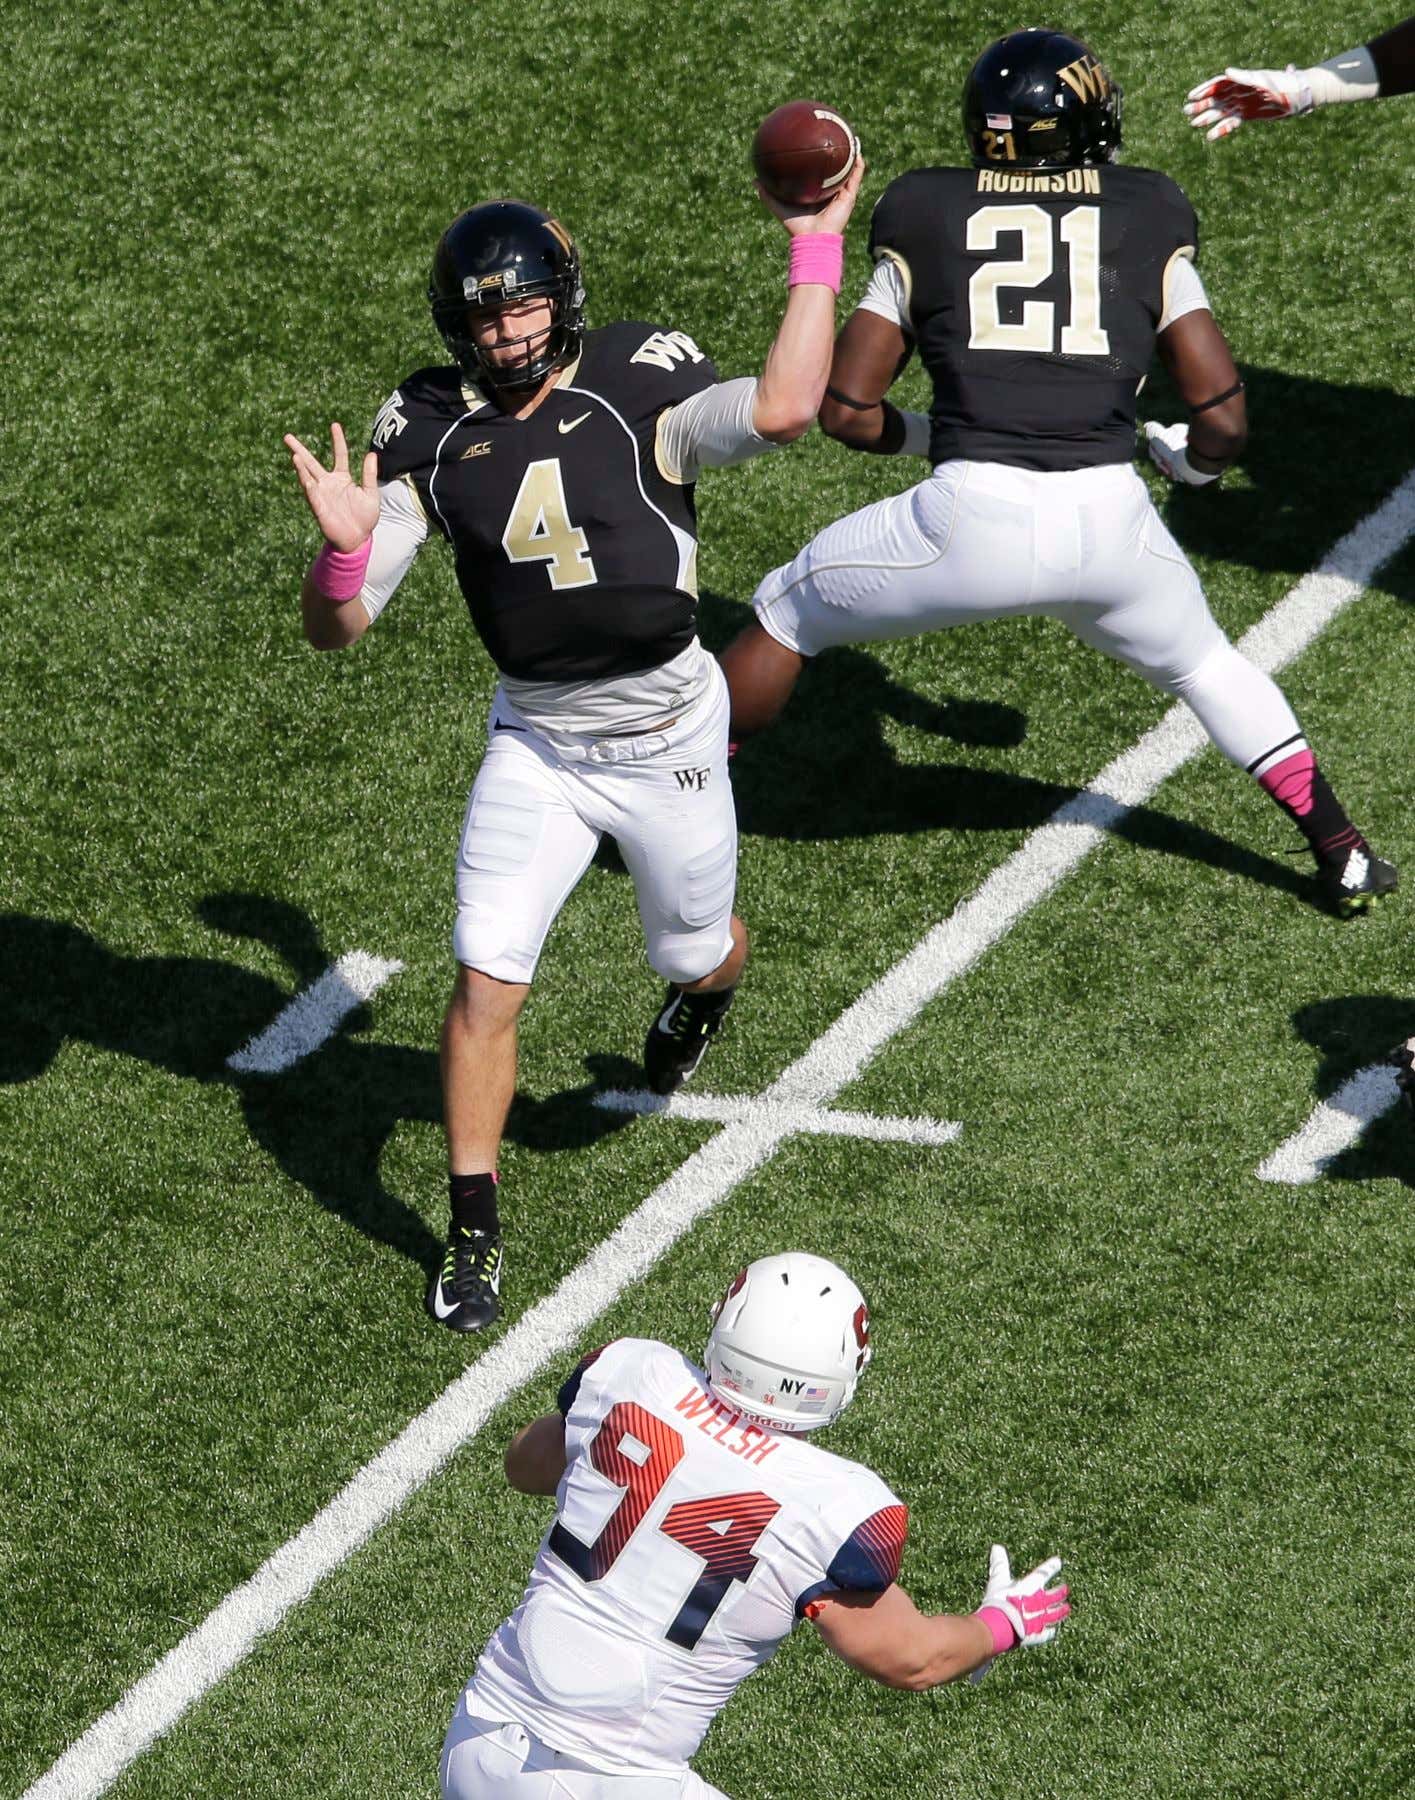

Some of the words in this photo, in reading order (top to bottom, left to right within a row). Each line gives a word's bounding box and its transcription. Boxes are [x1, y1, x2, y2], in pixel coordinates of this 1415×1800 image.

[1027, 117, 1058, 132] ACC
[982, 131, 1016, 160] 21
[478, 273, 503, 290] ACC
[966, 204, 1110, 355] 21
[460, 440, 493, 460] ACC
[502, 458, 598, 590] 4
[673, 767, 711, 792] WF
[780, 1378, 806, 1395] NY
[673, 1387, 780, 1465] WELSH
[547, 1400, 783, 1652] 94
